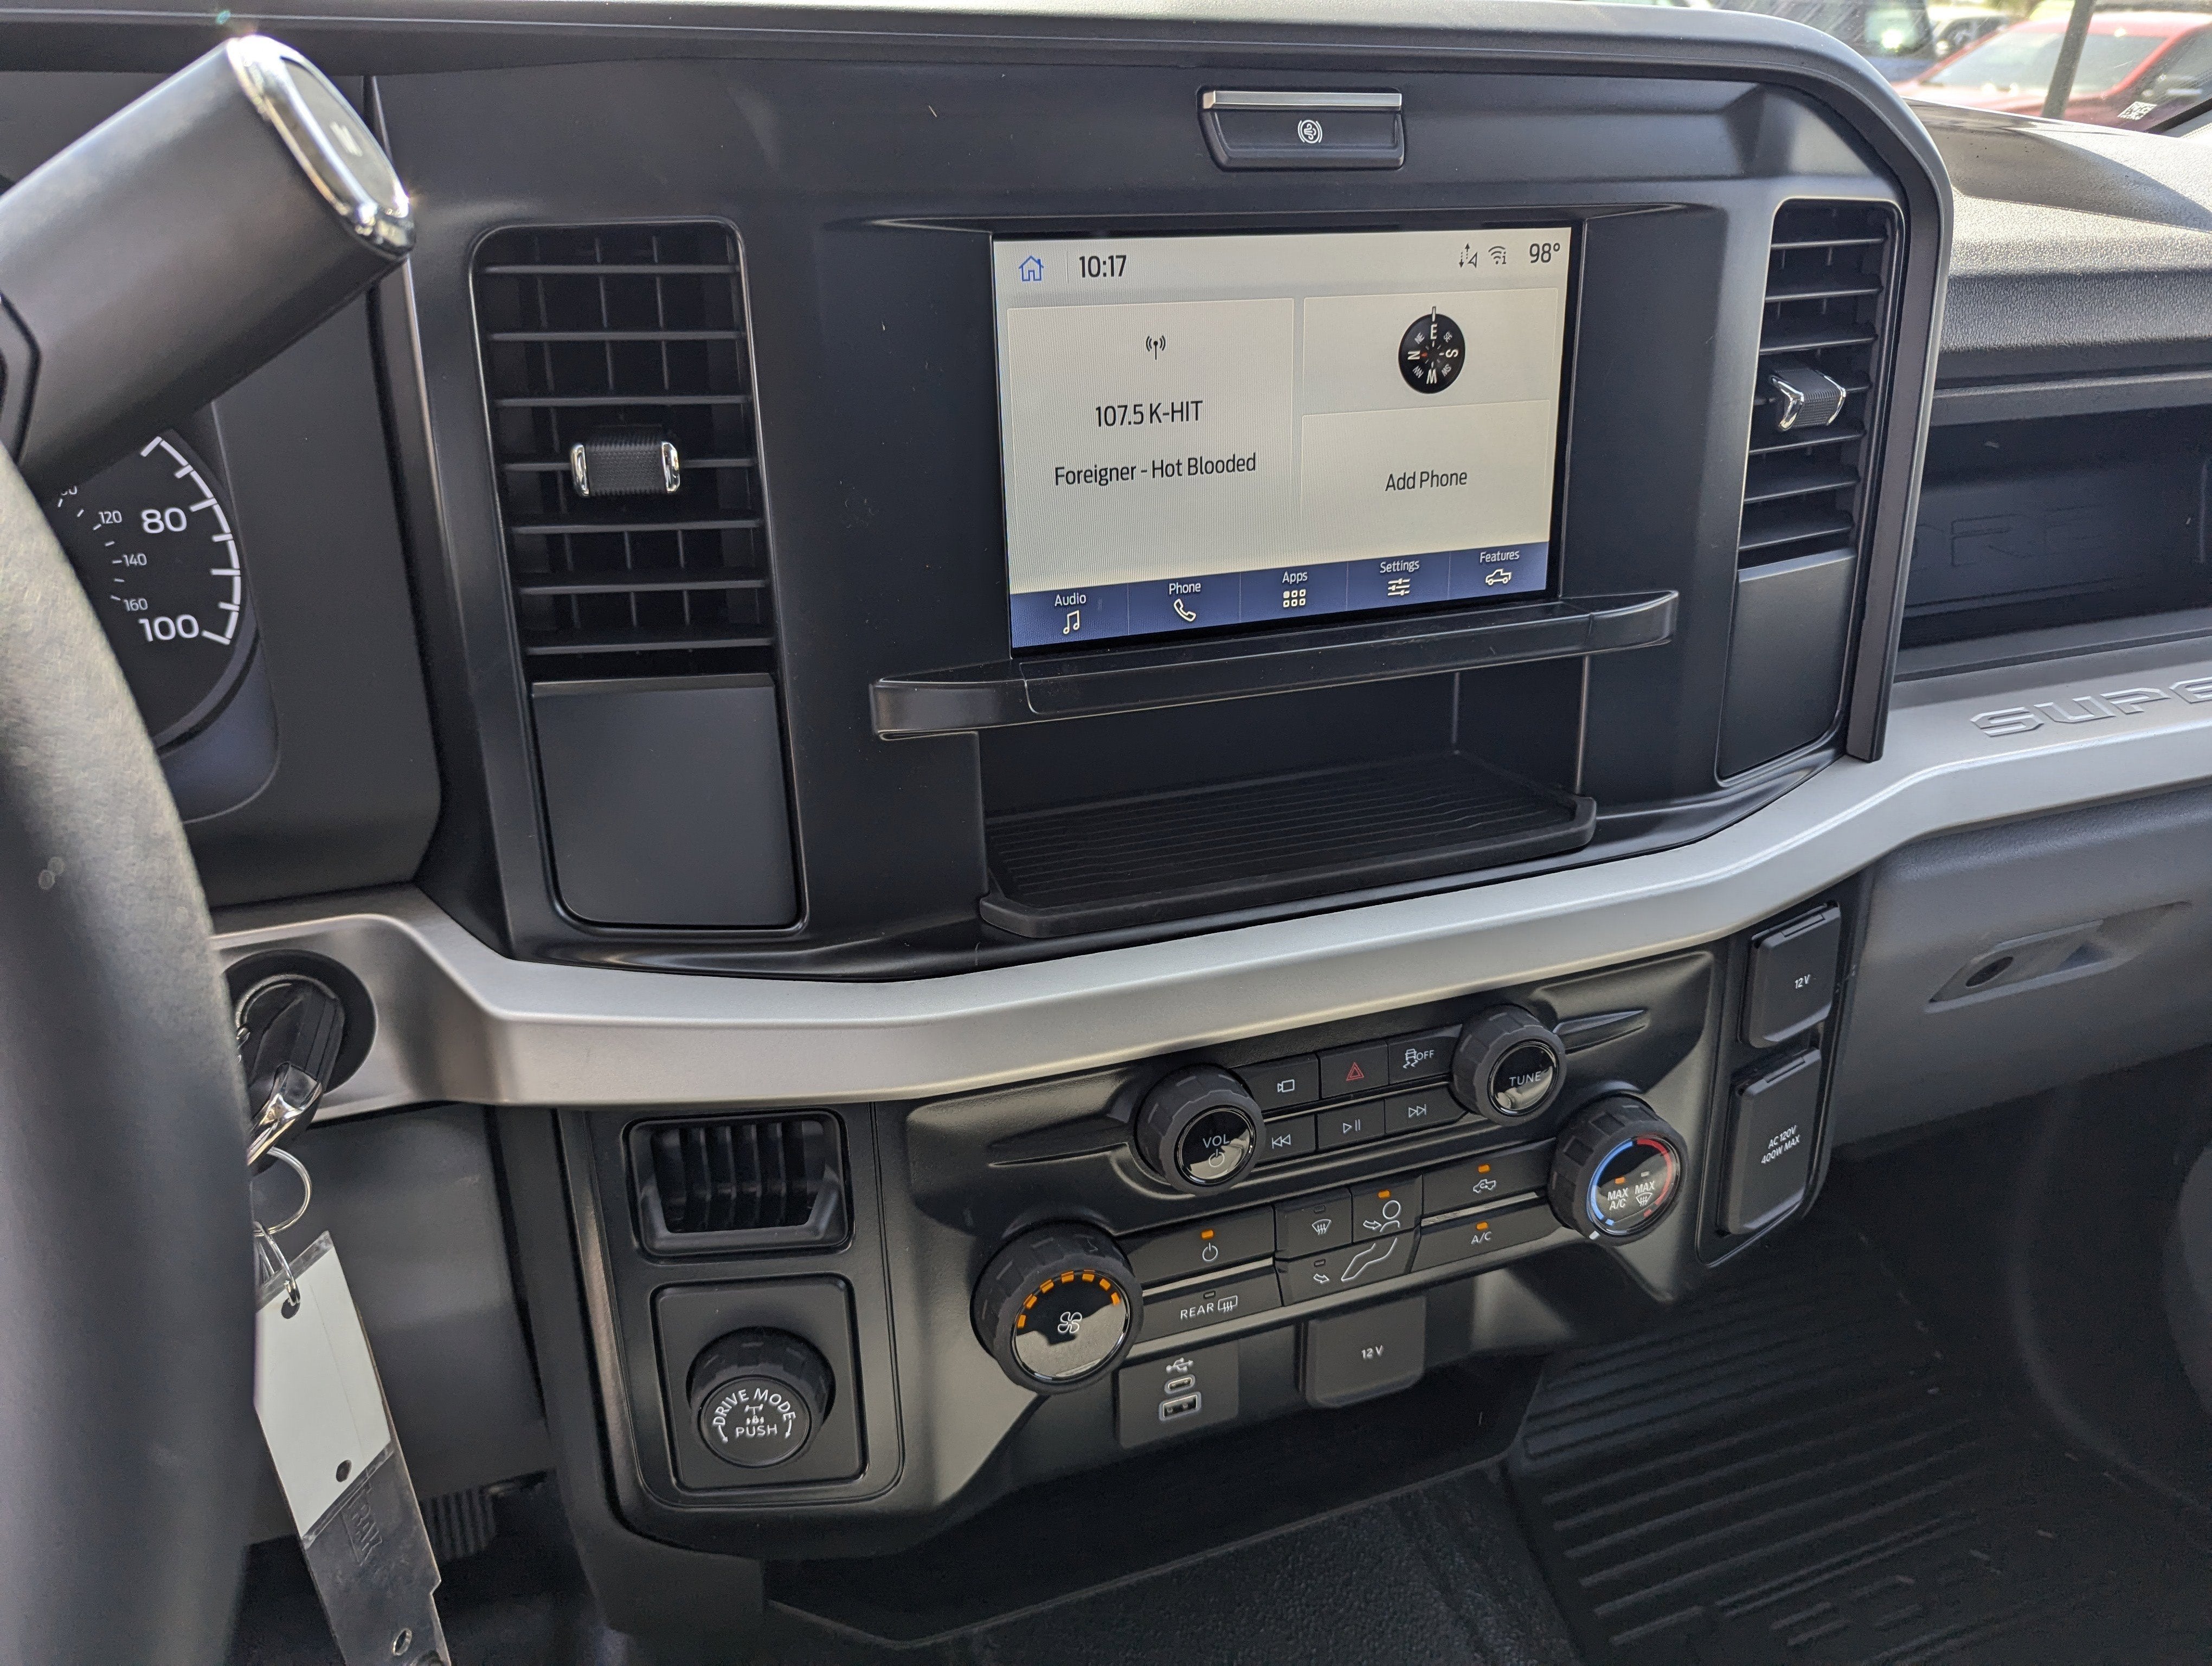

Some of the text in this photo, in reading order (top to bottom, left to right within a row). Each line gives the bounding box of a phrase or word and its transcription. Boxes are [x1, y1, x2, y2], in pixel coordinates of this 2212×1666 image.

[1529, 242, 1560, 264] 98°
[1079, 254, 1127, 278] 10:17
[1095, 400, 1203, 427] 107.5 K-HIT
[1055, 465, 1136, 486] Foreigner
[1152, 459, 1182, 478] Hot
[1187, 452, 1256, 476] Blooded
[1385, 470, 1467, 491] Add Phone
[98, 510, 123, 524] 120
[141, 507, 187, 534] 80
[123, 554, 147, 566] 140
[1480, 550, 1520, 563] Features
[1379, 559, 1419, 573] Settings
[1282, 571, 1308, 584] Apps
[1169, 581, 1201, 595] Phone
[124, 598, 148, 612] 160
[1054, 592, 1086, 607] Audio
[138, 614, 199, 642] 100
[1417, 1049, 1435, 1061] OFF
[1509, 1071, 1541, 1086] TUNE
[1203, 1133, 1230, 1149] VOL
[1768, 1125, 1797, 1149] AC 120V
[1761, 1135, 1801, 1164] 400W MAX
[1607, 1188, 1628, 1201] MAX
[1635, 1181, 1655, 1194] MAX
[1609, 1198, 1627, 1210] A/C
[1471, 1231, 1492, 1245] A/C
[1180, 1302, 1214, 1321] REAR
[713, 1388, 796, 1426] DRIVE MODE
[735, 1424, 777, 1438] PUSH
